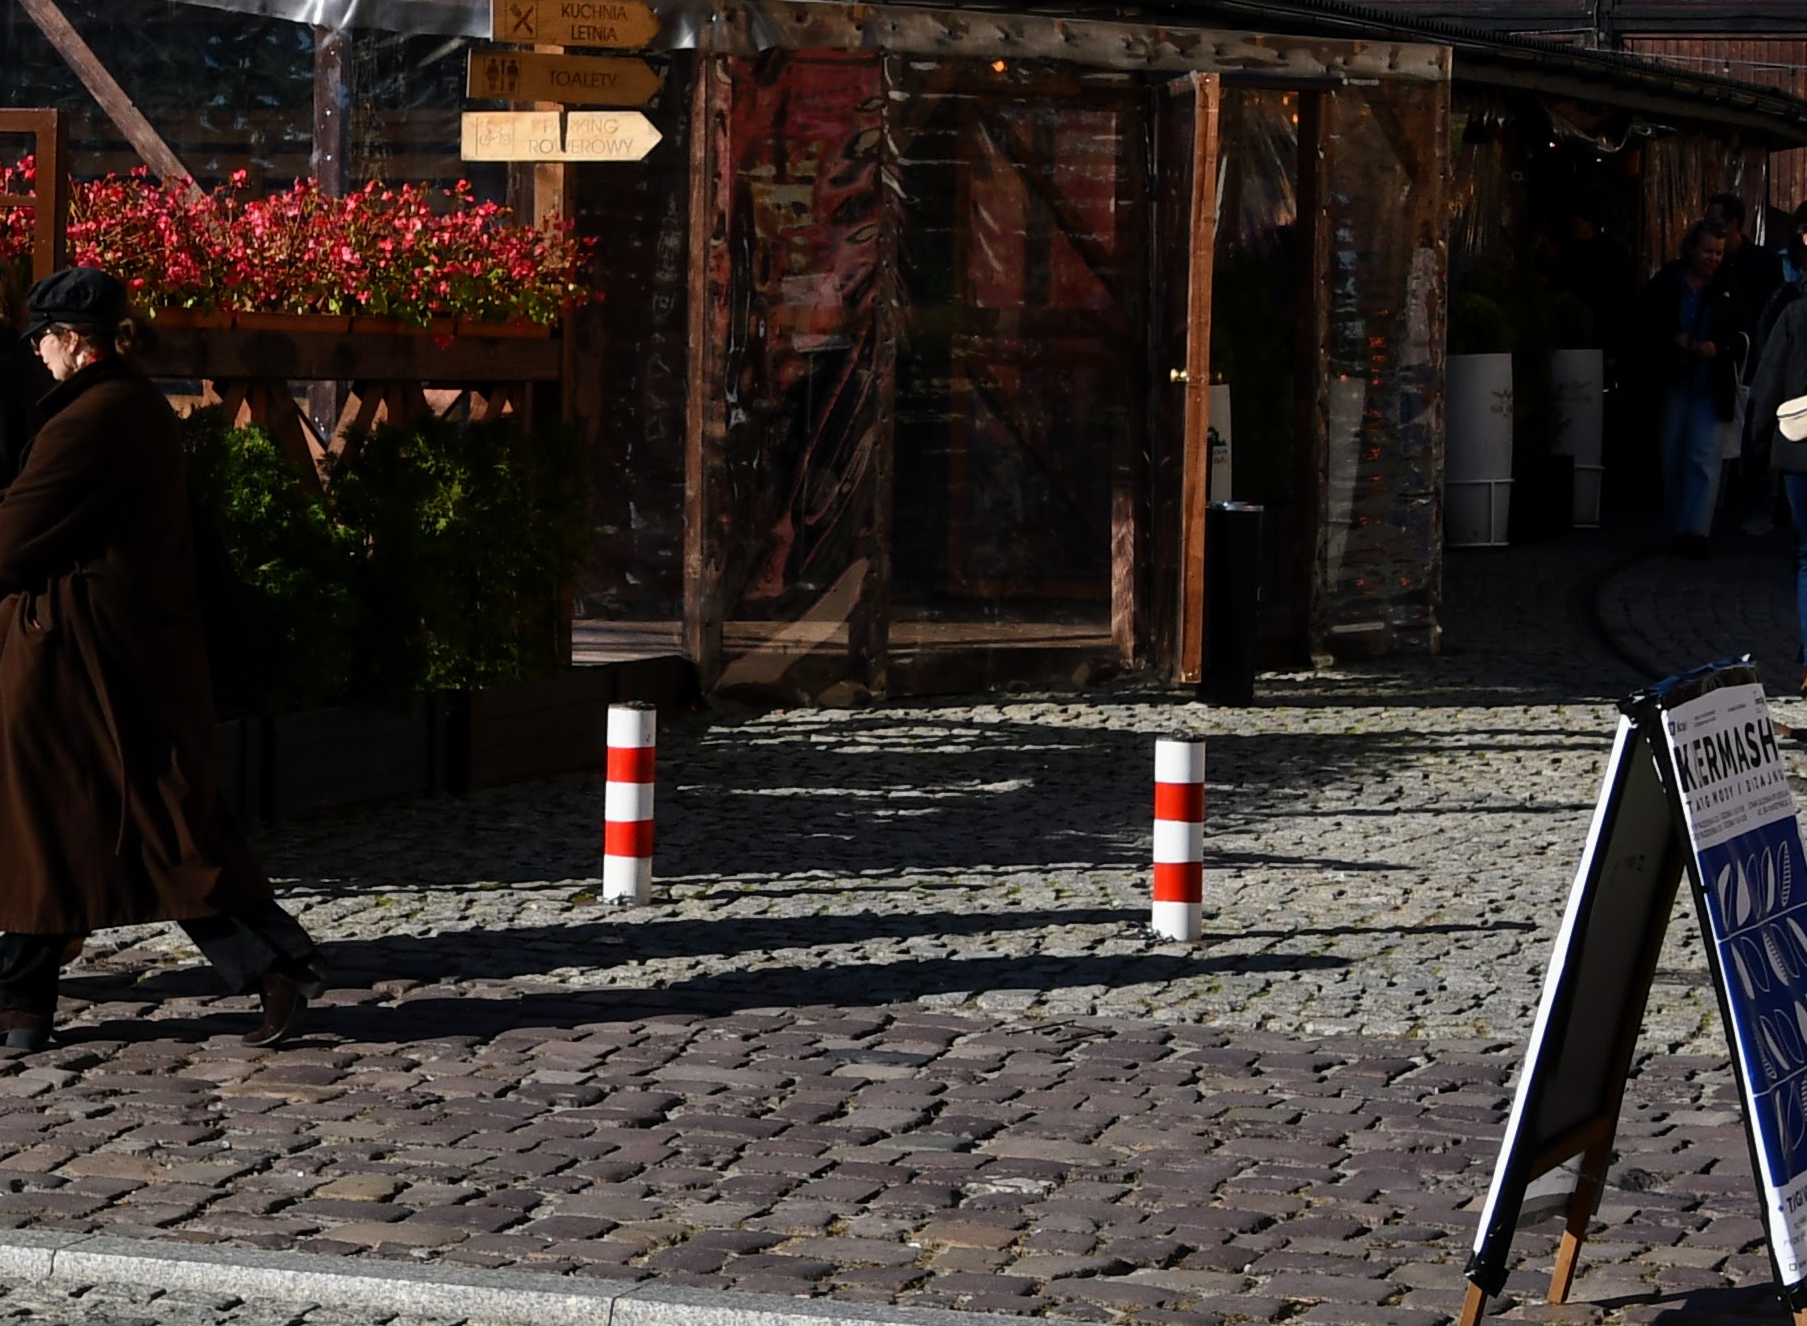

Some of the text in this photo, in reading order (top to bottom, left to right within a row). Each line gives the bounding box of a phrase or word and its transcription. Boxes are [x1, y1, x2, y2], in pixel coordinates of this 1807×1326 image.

[561, 3, 627, 19] KUCHNIA
[571, 26, 618, 42] LETNIA
[550, 71, 616, 86] TOALETY
[1674, 717, 1779, 793] KERMASH
